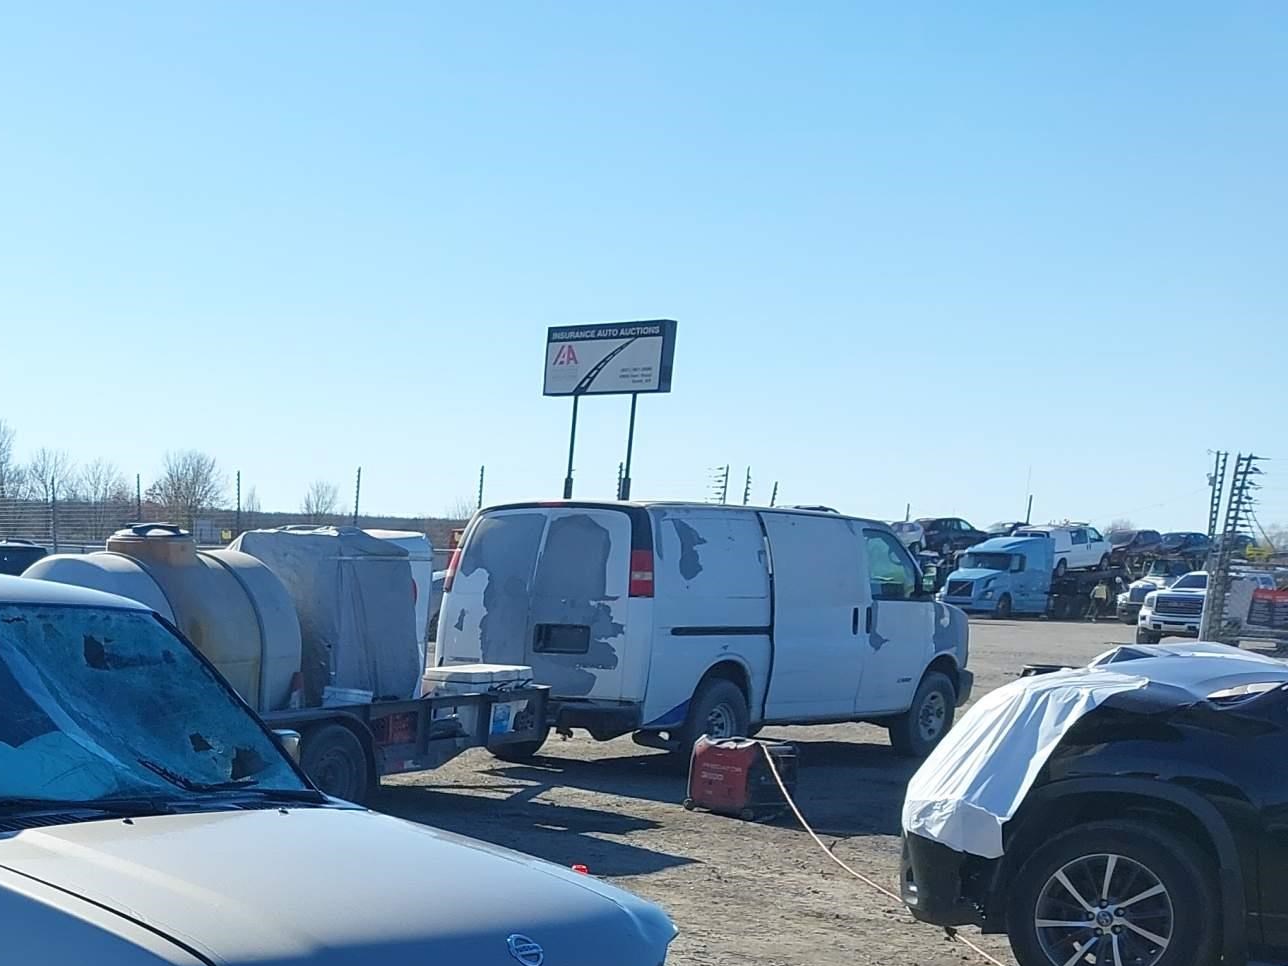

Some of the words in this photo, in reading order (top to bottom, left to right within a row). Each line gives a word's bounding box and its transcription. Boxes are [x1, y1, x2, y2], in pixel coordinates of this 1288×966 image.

[552, 330, 596, 341] INSURANCE
[597, 329, 618, 337] AUTO
[619, 326, 660, 336] AUCTIONS
